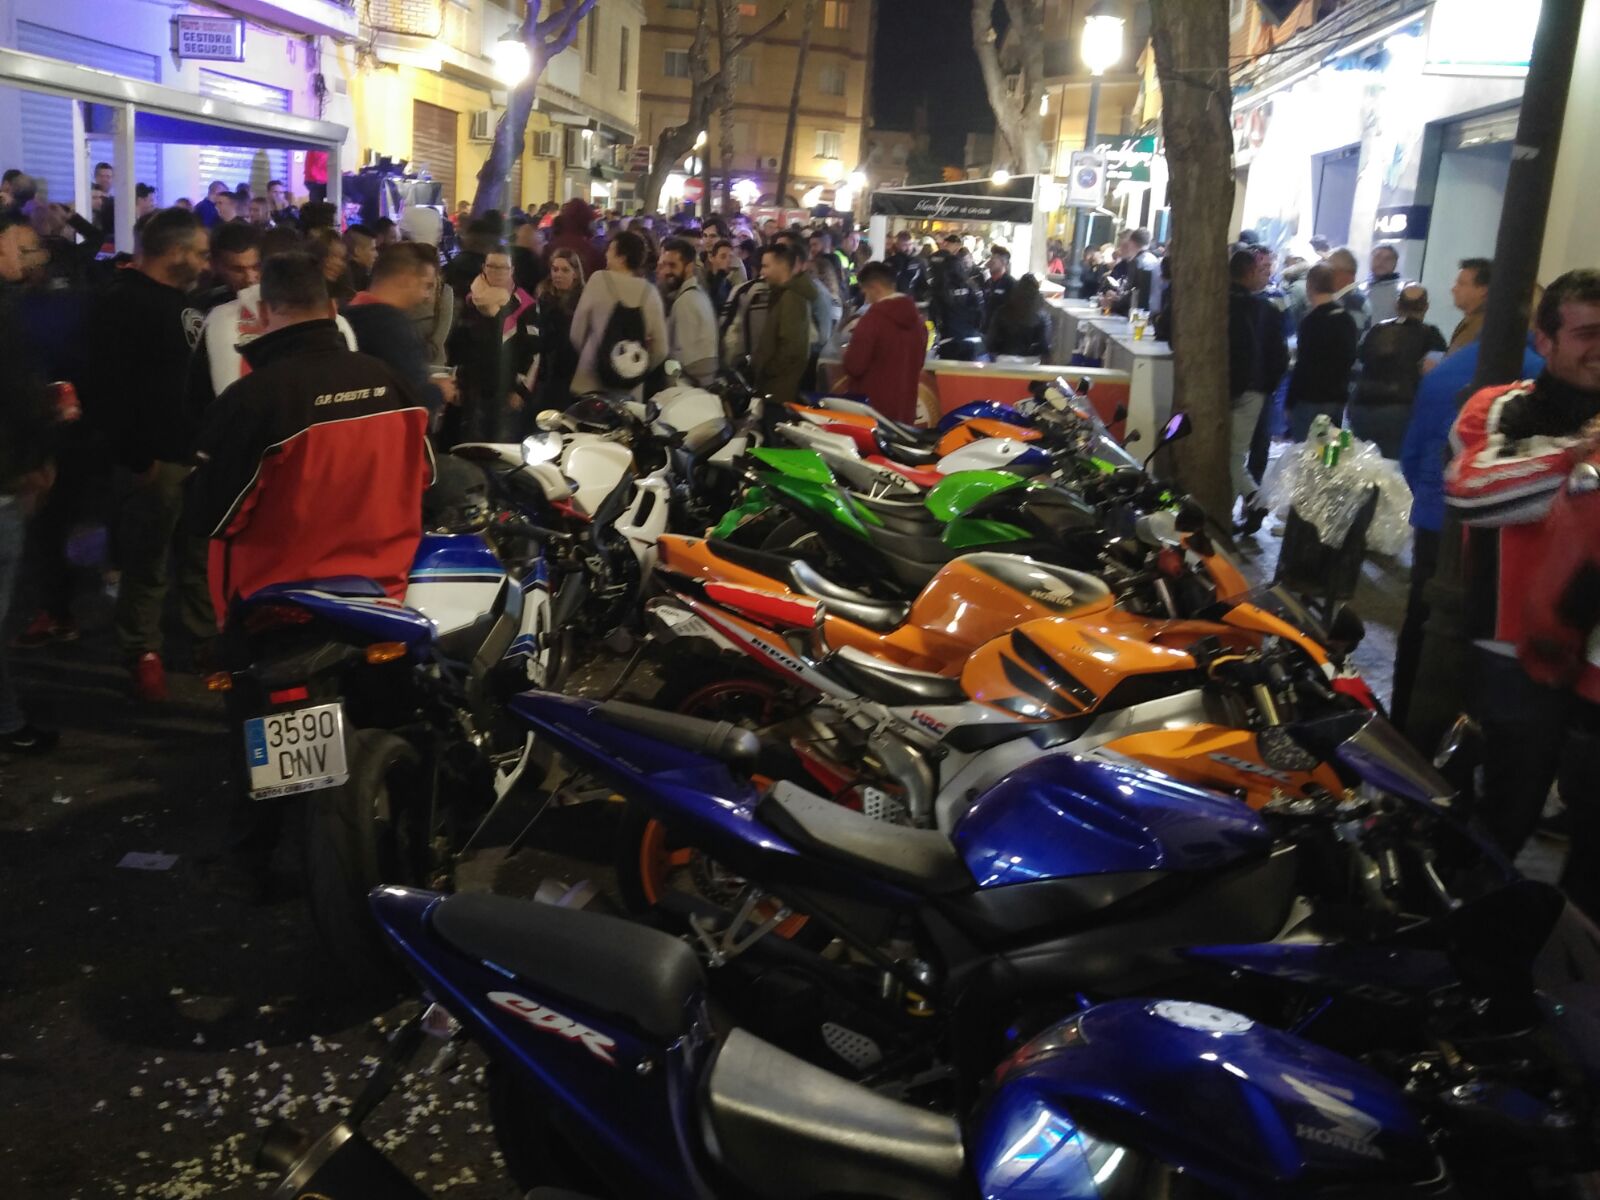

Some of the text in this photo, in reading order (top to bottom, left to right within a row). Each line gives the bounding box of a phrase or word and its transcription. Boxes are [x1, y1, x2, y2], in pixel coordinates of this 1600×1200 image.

[183, 32, 232, 44] GESTORIA
[184, 43, 232, 55] SEGUROS
[268, 711, 334, 748] 3590
[254, 747, 265, 760] E
[279, 743, 327, 780] DNV
[486, 991, 616, 1066] CBR
[1296, 1123, 1385, 1160] HONDA
